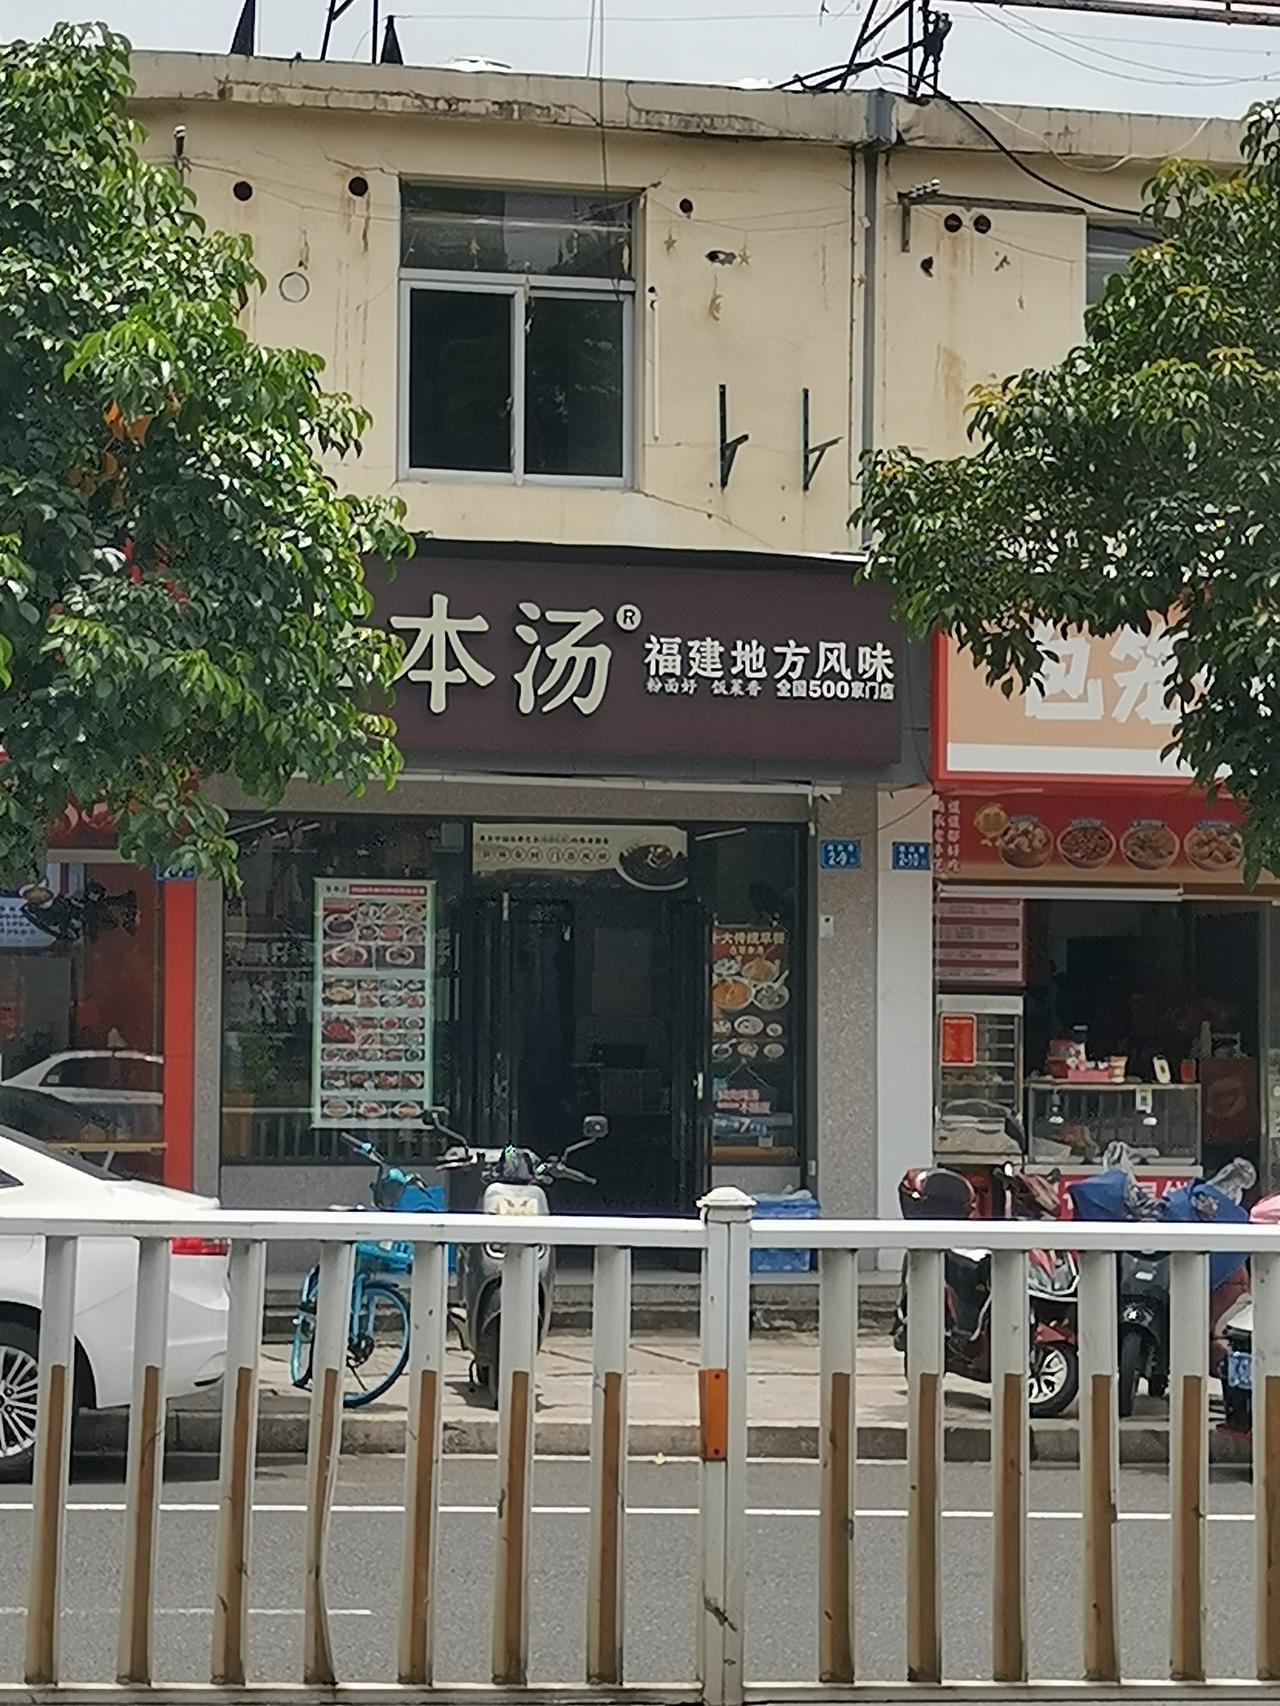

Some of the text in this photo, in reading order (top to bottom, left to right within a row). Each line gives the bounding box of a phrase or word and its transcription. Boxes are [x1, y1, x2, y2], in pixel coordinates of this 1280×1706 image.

[644, 635, 895, 682] 福建地方风味
[776, 678, 895, 700] 全国500家门店
